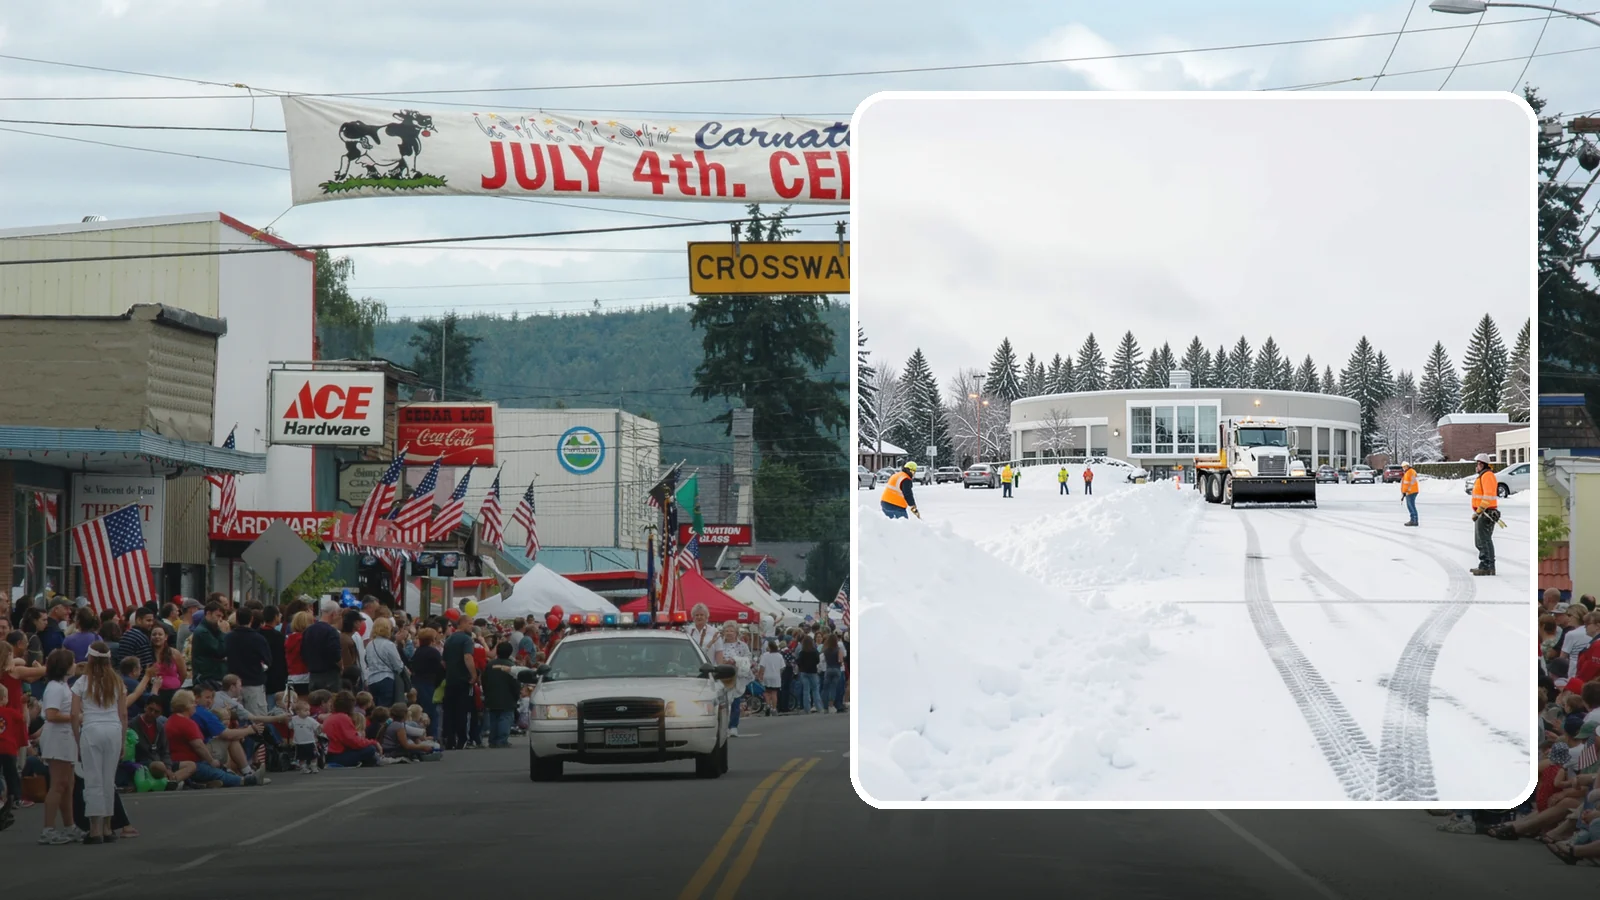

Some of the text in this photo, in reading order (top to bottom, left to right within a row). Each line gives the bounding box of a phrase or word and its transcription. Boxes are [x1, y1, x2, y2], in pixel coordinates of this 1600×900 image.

[480, 141, 605, 193] JULY
[632, 149, 746, 197] 4th.
[697, 254, 850, 281] CROSSWA
[283, 380, 373, 420] ACE
[406, 409, 452, 421] CEDAR
[283, 421, 371, 436] Hardware
[83, 484, 155, 495] St. Vincent de Paul
[688, 526, 741, 535] CRNATION
[699, 535, 730, 543] GLASS
